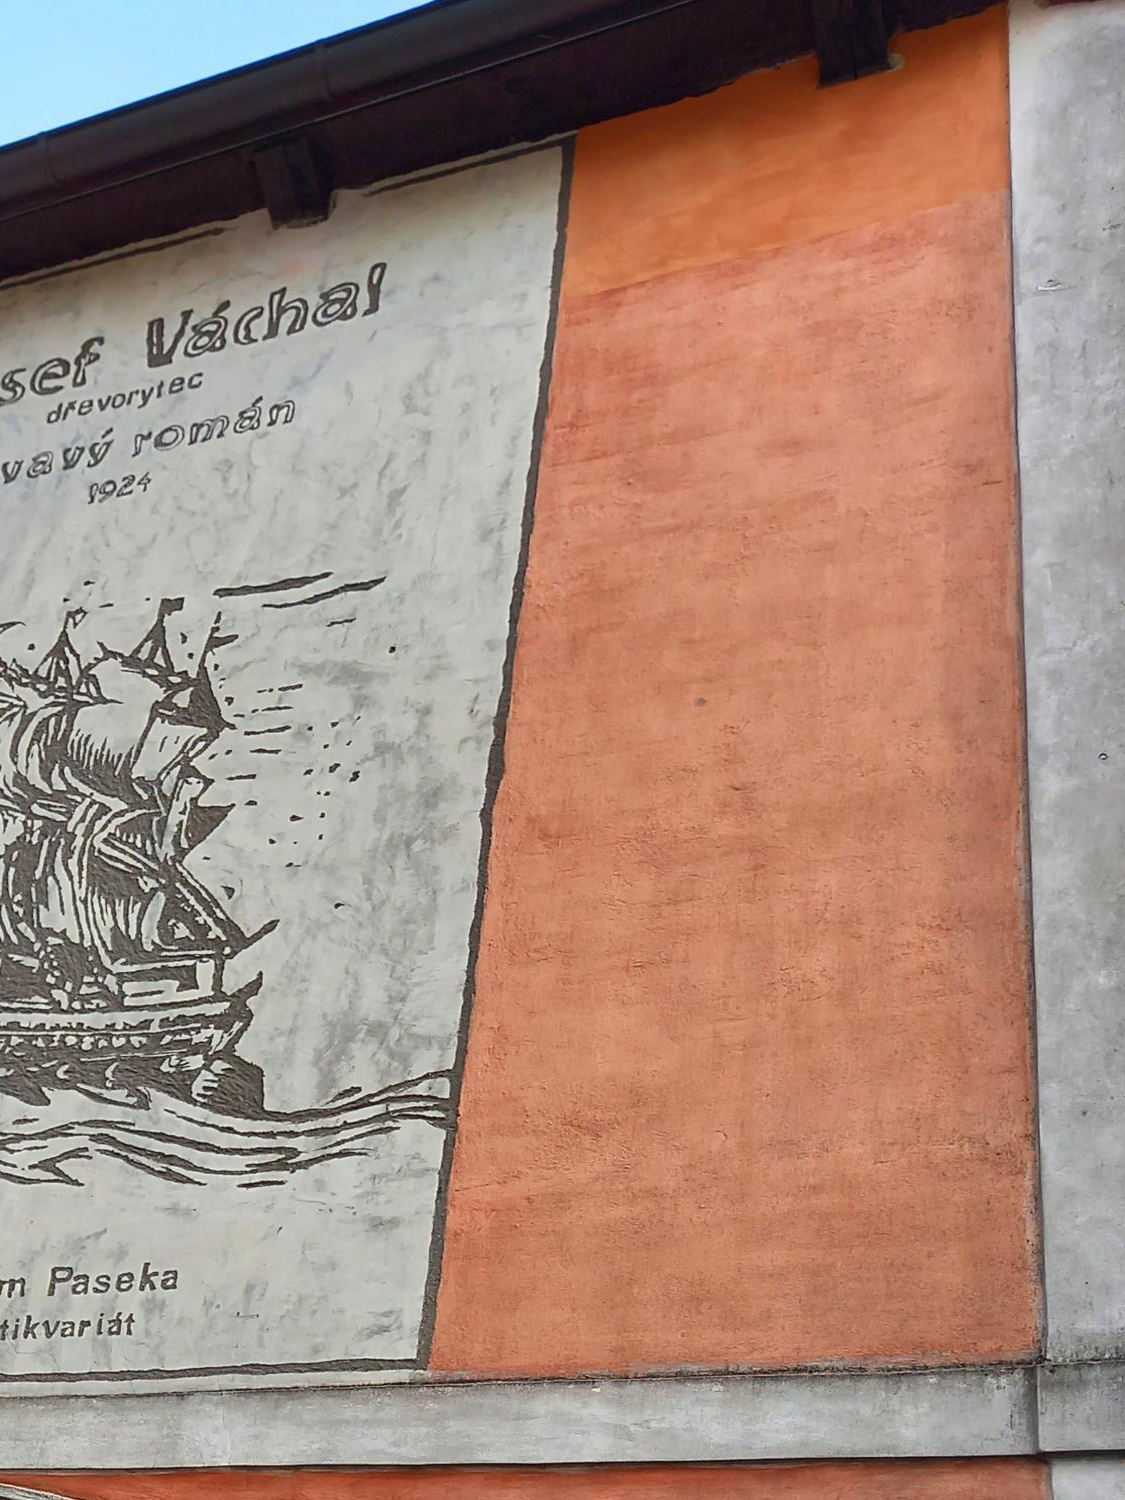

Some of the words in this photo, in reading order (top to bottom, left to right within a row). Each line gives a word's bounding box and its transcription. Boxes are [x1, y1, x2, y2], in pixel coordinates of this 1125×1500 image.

[146, 261, 387, 368] Váchal
[131, 395, 296, 458] román
[87, 471, 152, 504] 1924
[46, 1262, 179, 1297] Paseka
